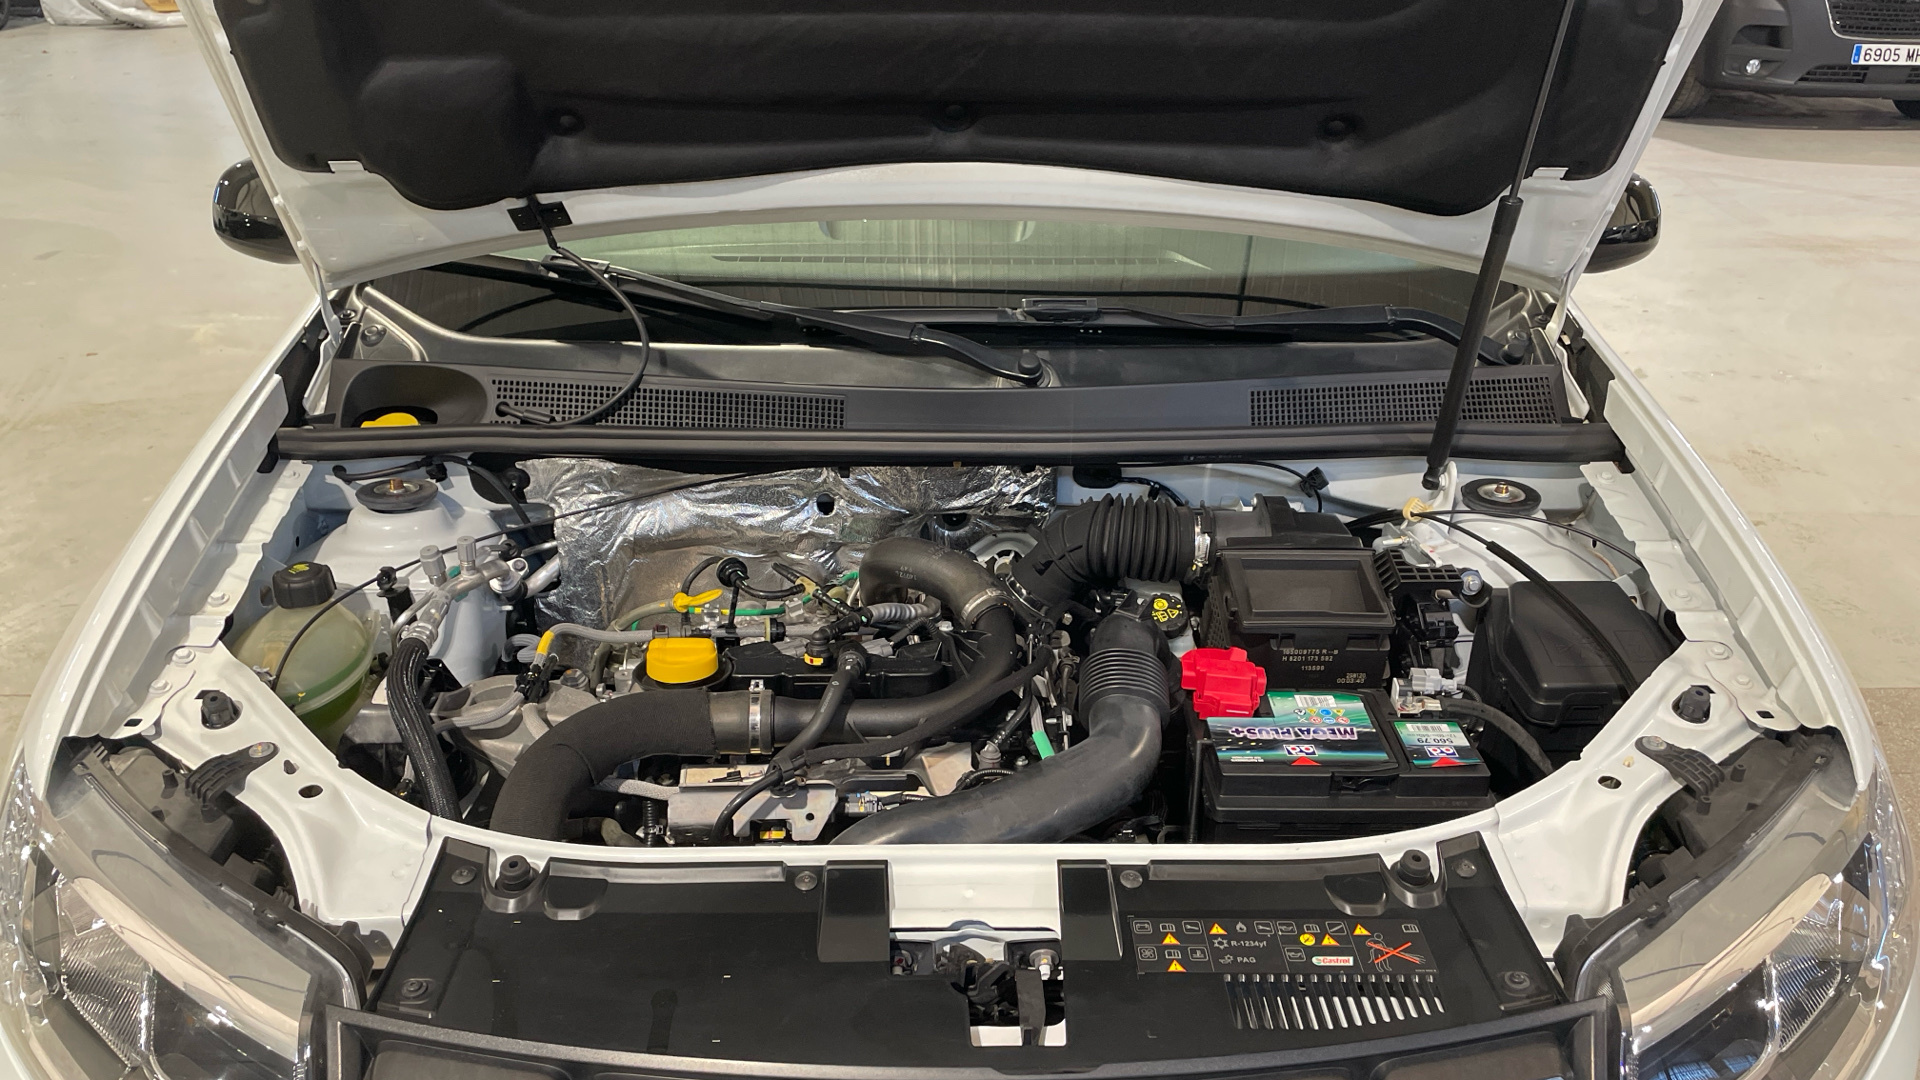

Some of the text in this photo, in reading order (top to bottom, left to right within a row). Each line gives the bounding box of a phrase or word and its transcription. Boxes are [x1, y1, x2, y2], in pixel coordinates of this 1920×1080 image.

[1864, 48, 1900, 62] 6905
[1229, 727, 1357, 740] MEGA PLUS+
[1230, 940, 1267, 950] R-1234yf
[1321, 957, 1351, 965] Castrol
